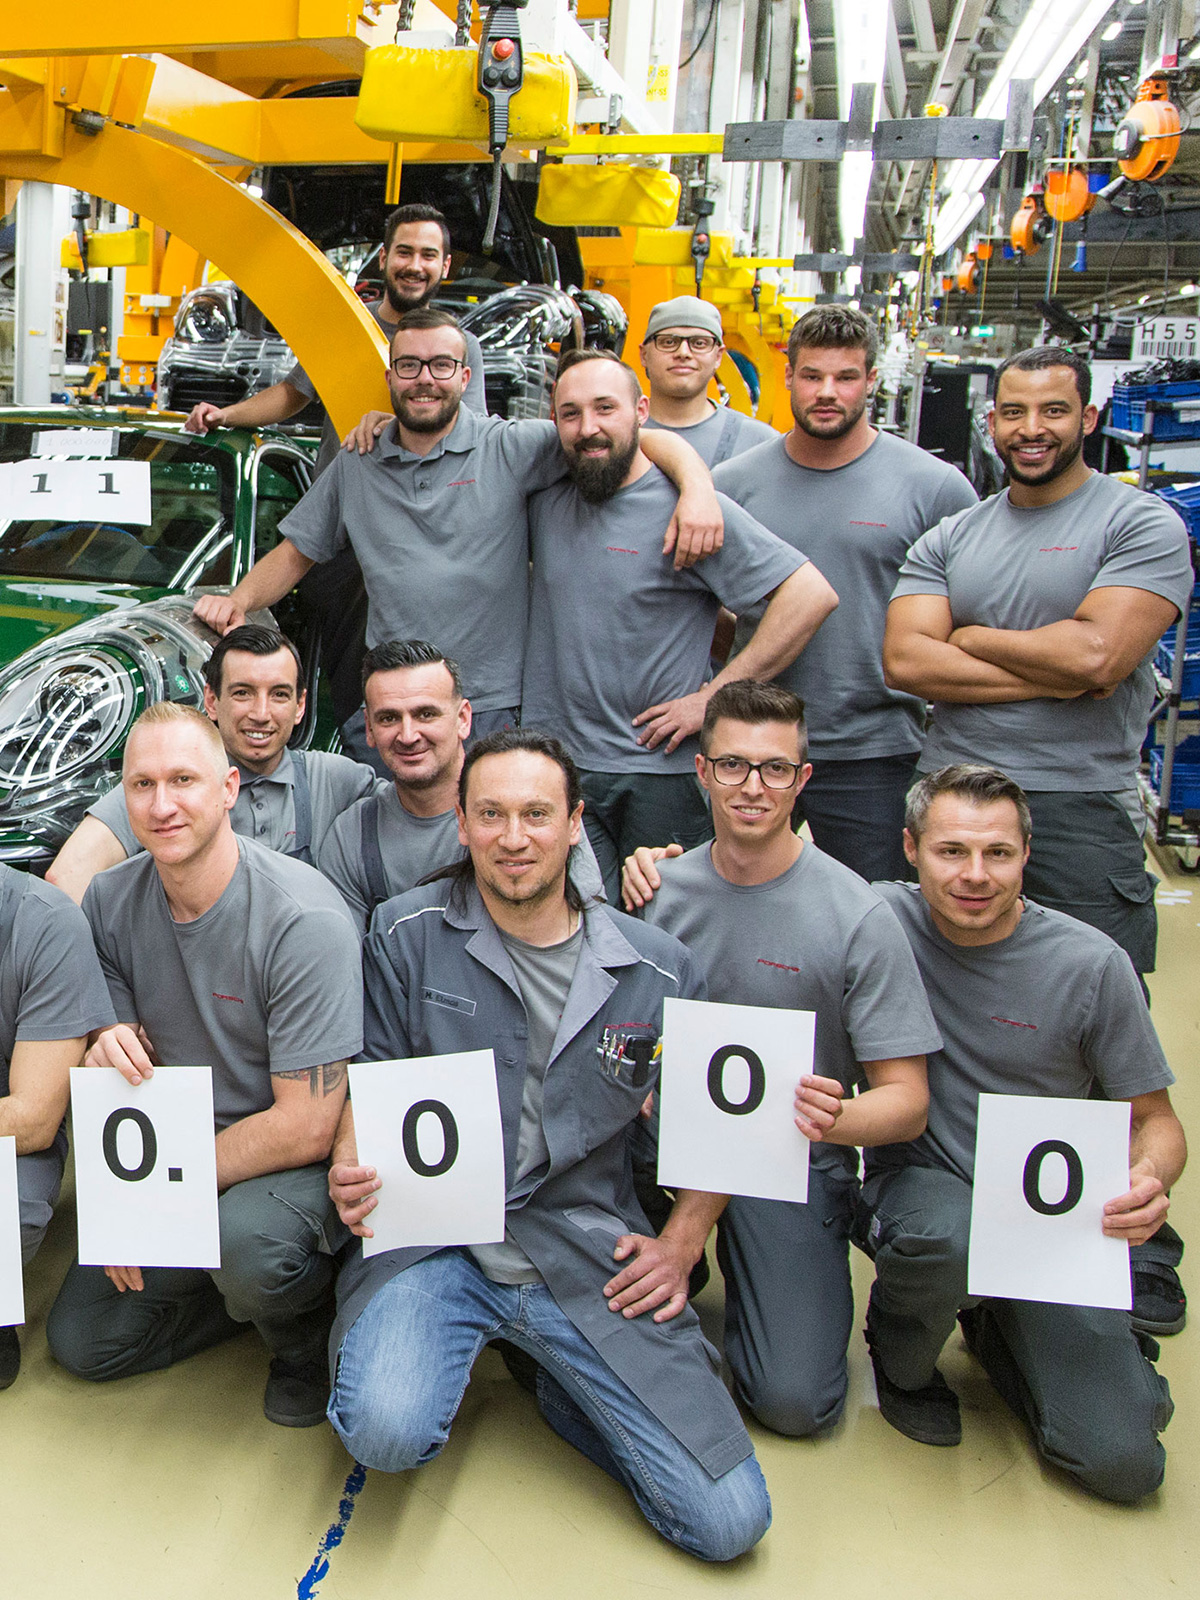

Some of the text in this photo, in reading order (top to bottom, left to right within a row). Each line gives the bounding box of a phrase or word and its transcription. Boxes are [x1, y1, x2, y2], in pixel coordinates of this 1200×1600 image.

[706, 1044, 766, 1116] 0
[102, 1107, 183, 1182] 0.
[402, 1099, 459, 1178] 0
[1022, 1139, 1084, 1216] 0
